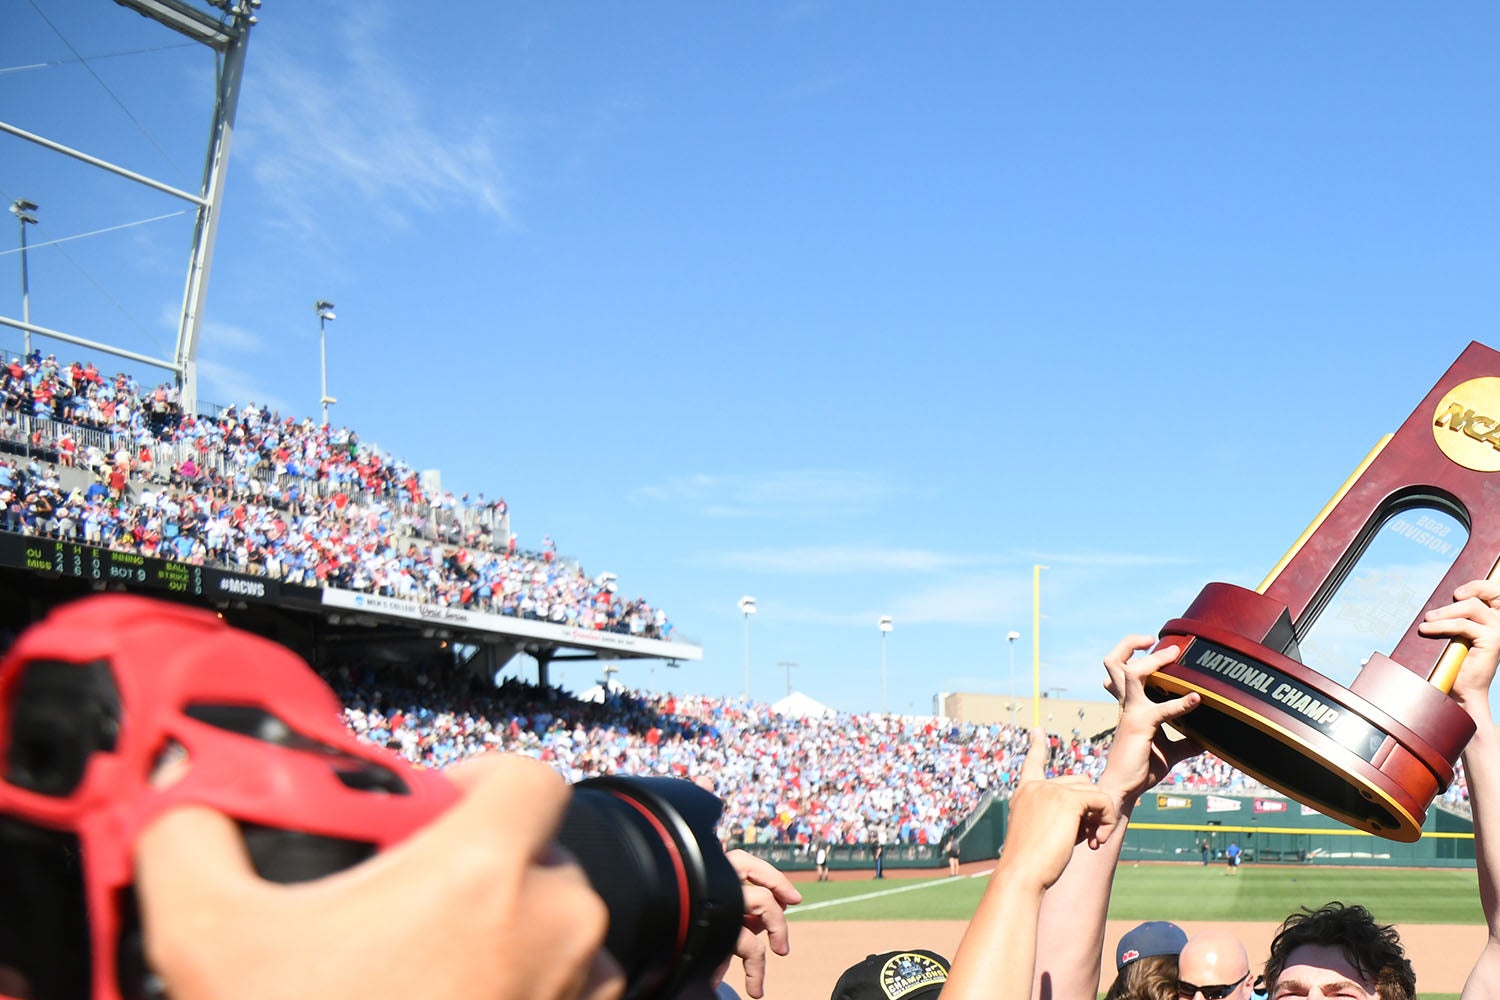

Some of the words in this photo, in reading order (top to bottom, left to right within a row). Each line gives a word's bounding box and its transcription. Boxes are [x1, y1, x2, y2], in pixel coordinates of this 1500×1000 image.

[1391, 519, 1451, 554] DIVISION
[26, 548, 42, 558] OU
[55, 553, 63, 563] 2
[73, 555, 81, 566] 3
[56, 542, 63, 551] R
[74, 545, 81, 554] H
[92, 549, 99, 557] E
[112, 552, 144, 565] INNING
[26, 559, 52, 570] MISS
[55, 563, 63, 574] 4
[110, 566, 133, 578] BOT
[137, 569, 146, 581] 9
[166, 562, 188, 573] BALL
[158, 571, 189, 582] STRIKE
[169, 581, 188, 592] OUT
[220, 578, 265, 597] #MCWS
[1196, 649, 1275, 694] NATIONAL
[1271, 683, 1340, 726] CHAMP
[885, 956, 938, 985] NATIONAL
[888, 970, 944, 992] CHAMPIONS
